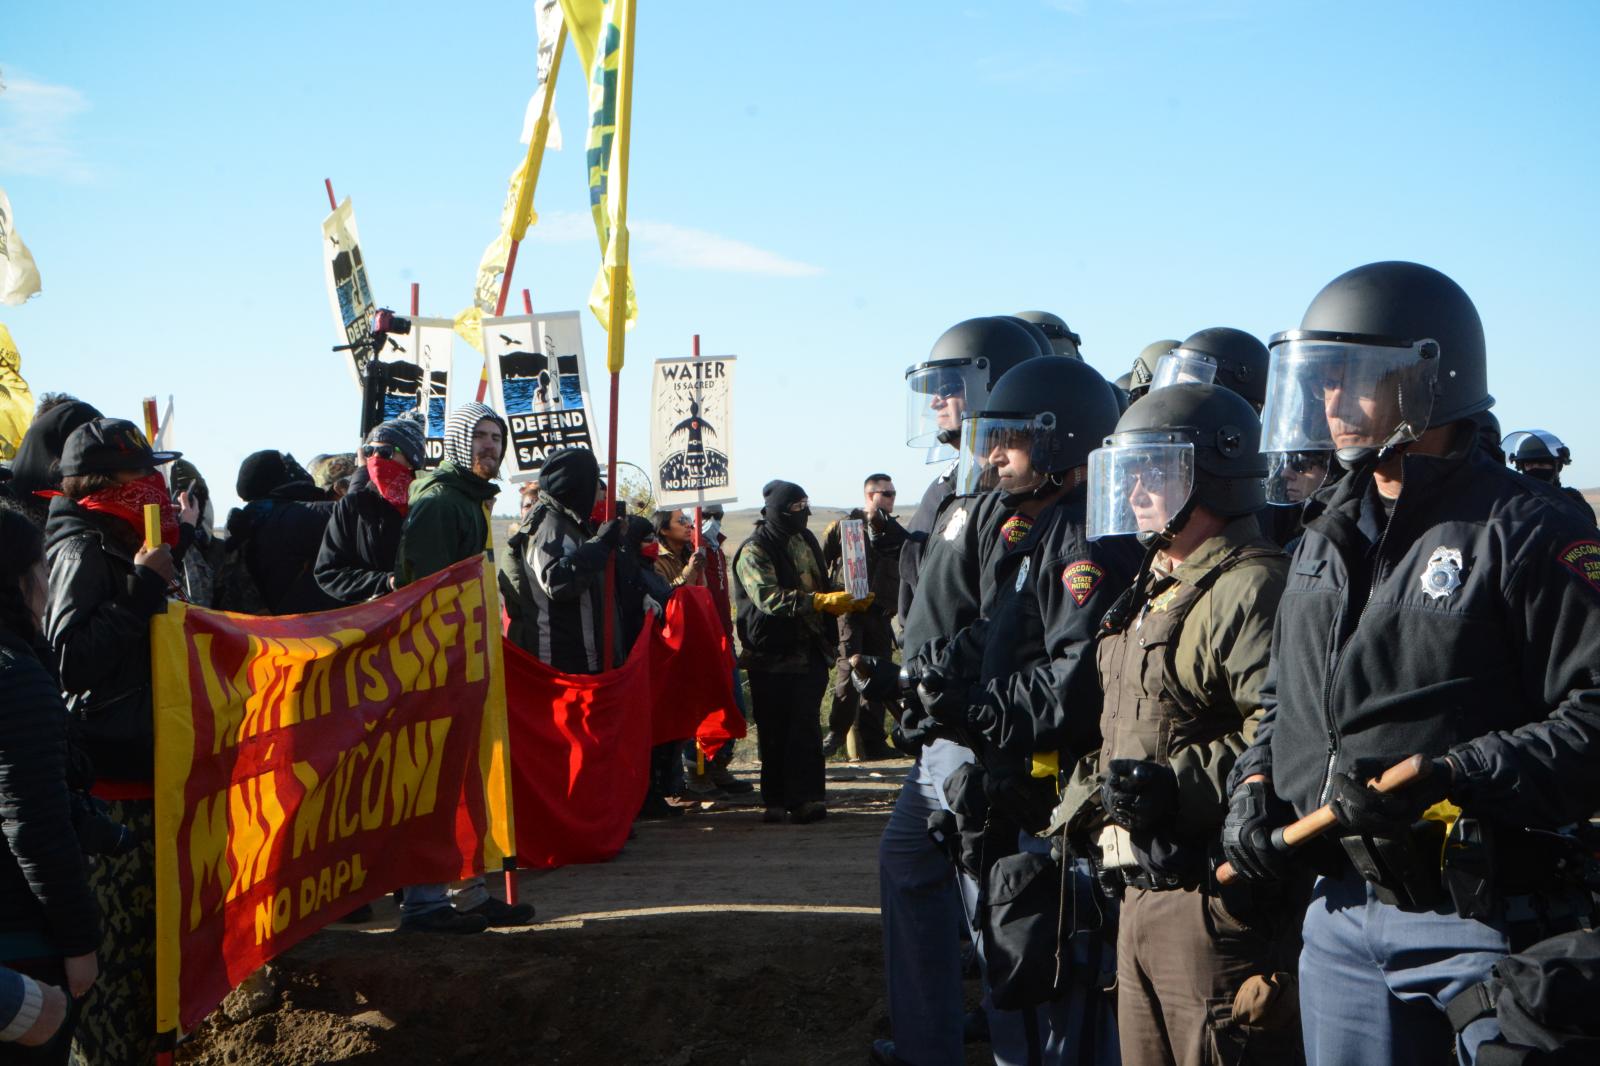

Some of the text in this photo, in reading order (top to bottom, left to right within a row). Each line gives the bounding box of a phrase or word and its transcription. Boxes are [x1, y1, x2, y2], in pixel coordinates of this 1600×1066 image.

[661, 361, 725, 381] WATER
[673, 380, 715, 391] IS SACRED
[511, 411, 584, 433] DEFEND
[541, 431, 562, 442] THE
[665, 476, 727, 489] NO PIPELINES!
[1064, 564, 1102, 579] WISCONSIN
[192, 577, 486, 755] WATER IS LIFE
[254, 853, 368, 946] NO DAPL
